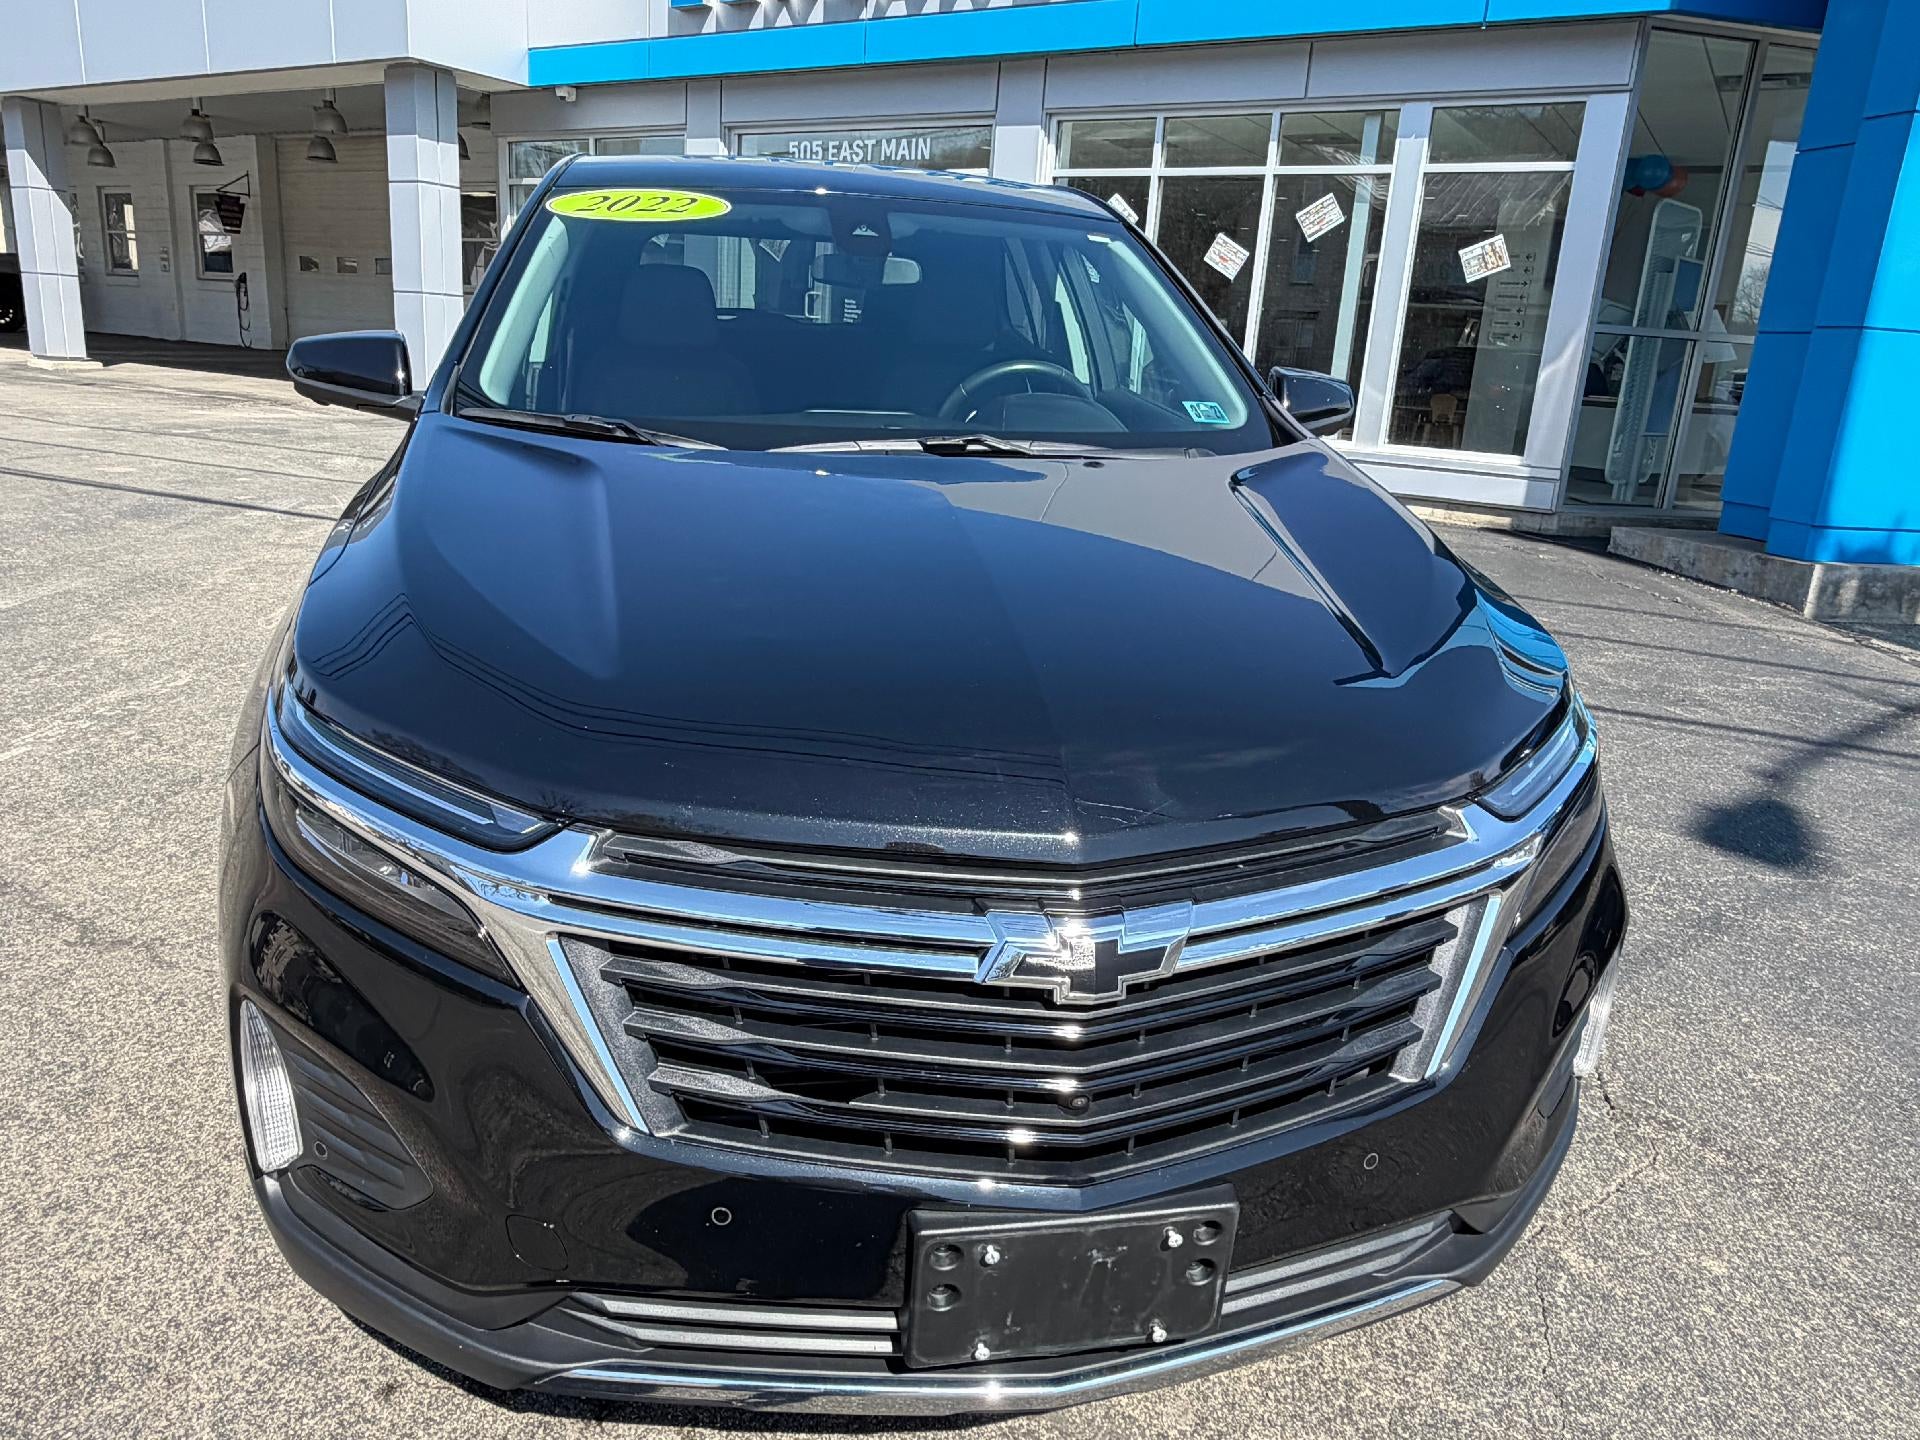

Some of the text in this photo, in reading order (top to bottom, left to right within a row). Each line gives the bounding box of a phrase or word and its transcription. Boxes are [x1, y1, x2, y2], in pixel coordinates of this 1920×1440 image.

[788, 137, 931, 162] 505 EAST MAIN
[574, 195, 698, 213] 2022
